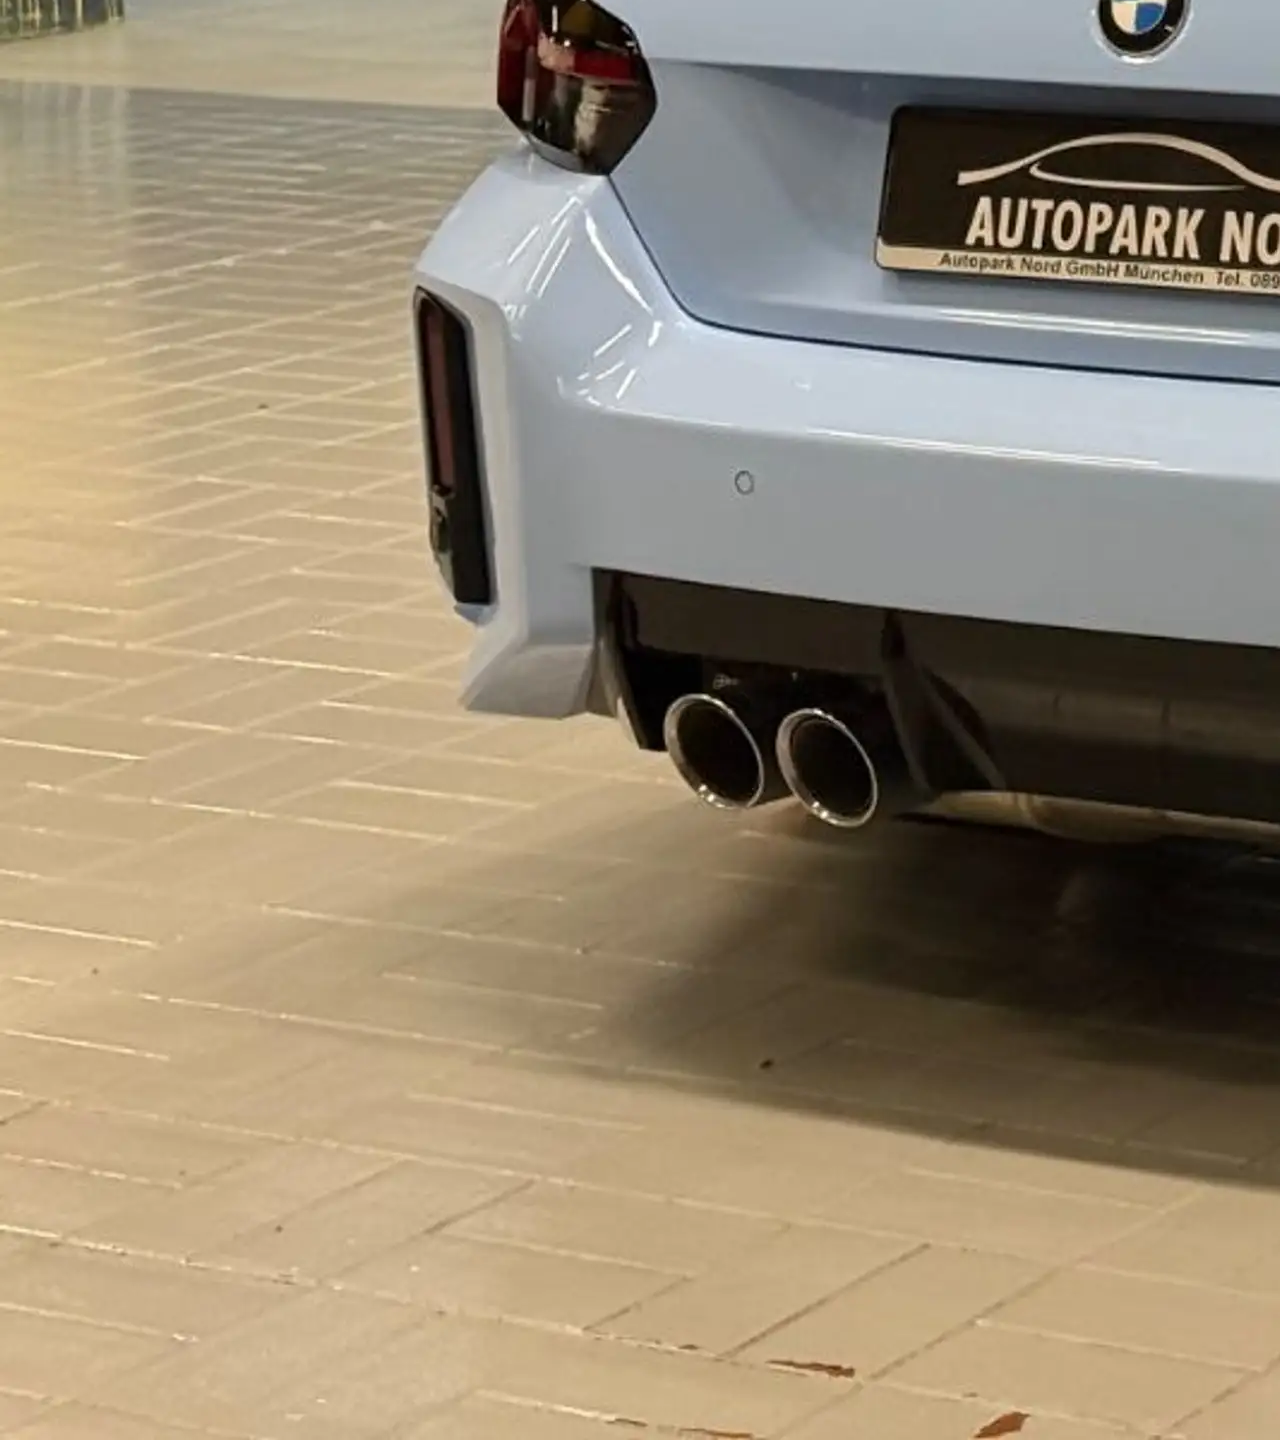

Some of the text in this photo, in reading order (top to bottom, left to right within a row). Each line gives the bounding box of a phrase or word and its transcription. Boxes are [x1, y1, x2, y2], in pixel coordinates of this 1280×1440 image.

[964, 195, 1206, 259] AUTOPARK
[939, 252, 1015, 272] Autopark
[1020, 257, 1063, 274] Nord
[1066, 260, 1120, 277] GmbH
[1215, 271, 1245, 287] Tel.
